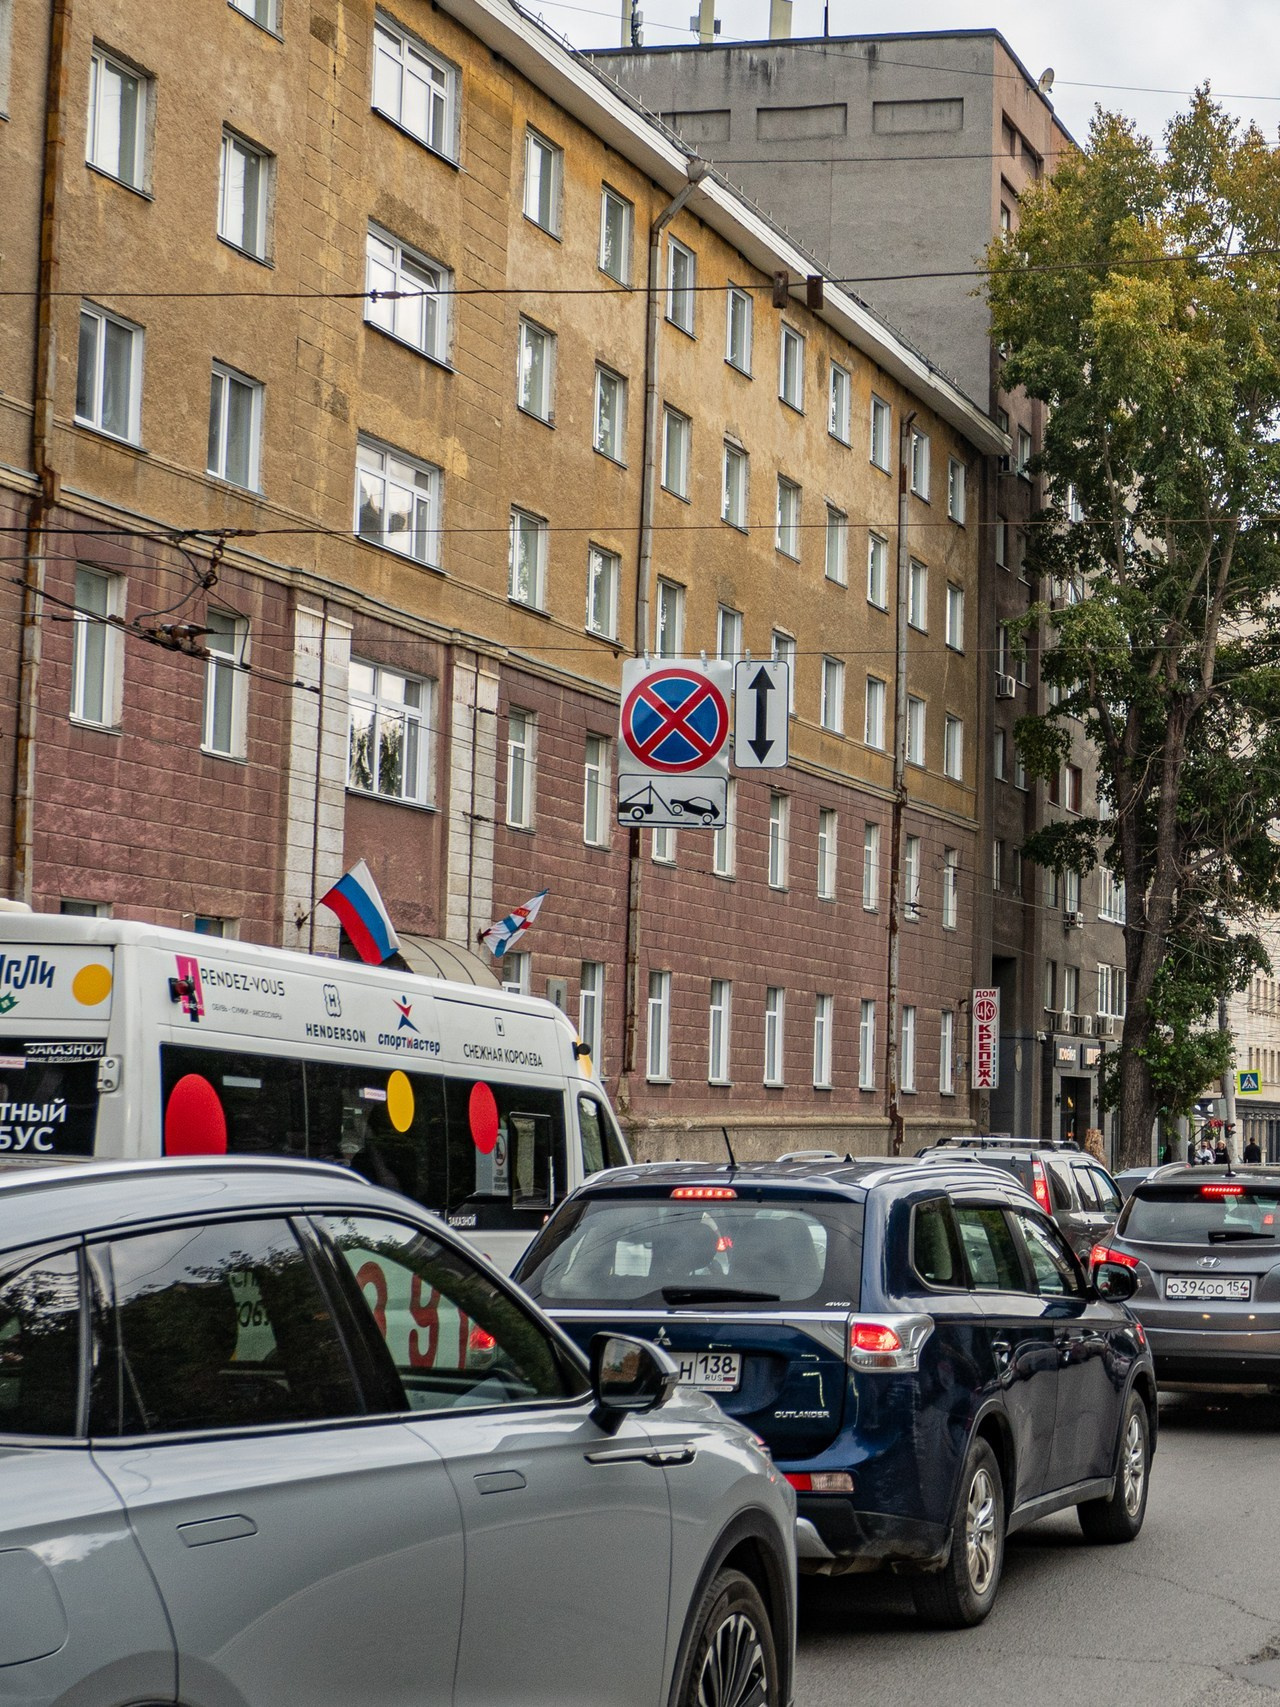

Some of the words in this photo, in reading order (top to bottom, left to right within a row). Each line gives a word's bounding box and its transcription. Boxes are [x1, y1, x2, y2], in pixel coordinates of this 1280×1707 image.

[201, 968, 285, 996] RENDEZ-VOUS
[306, 1023, 366, 1043] HENDERSON
[378, 1032, 440, 1055] спортмастер
[463, 1043, 503, 1062] СНЕЖНАЯ
[504, 1047, 543, 1067] КОРОЛЕВА
[978, 1025, 991, 1087] КРЕПЕЖА
[448, 1214, 476, 1227] ЗАКАЗНОЙ
[1227, 1282, 1246, 1292] 154
[699, 1355, 731, 1374] 138
[775, 1410, 830, 1418] OUTLANDER
